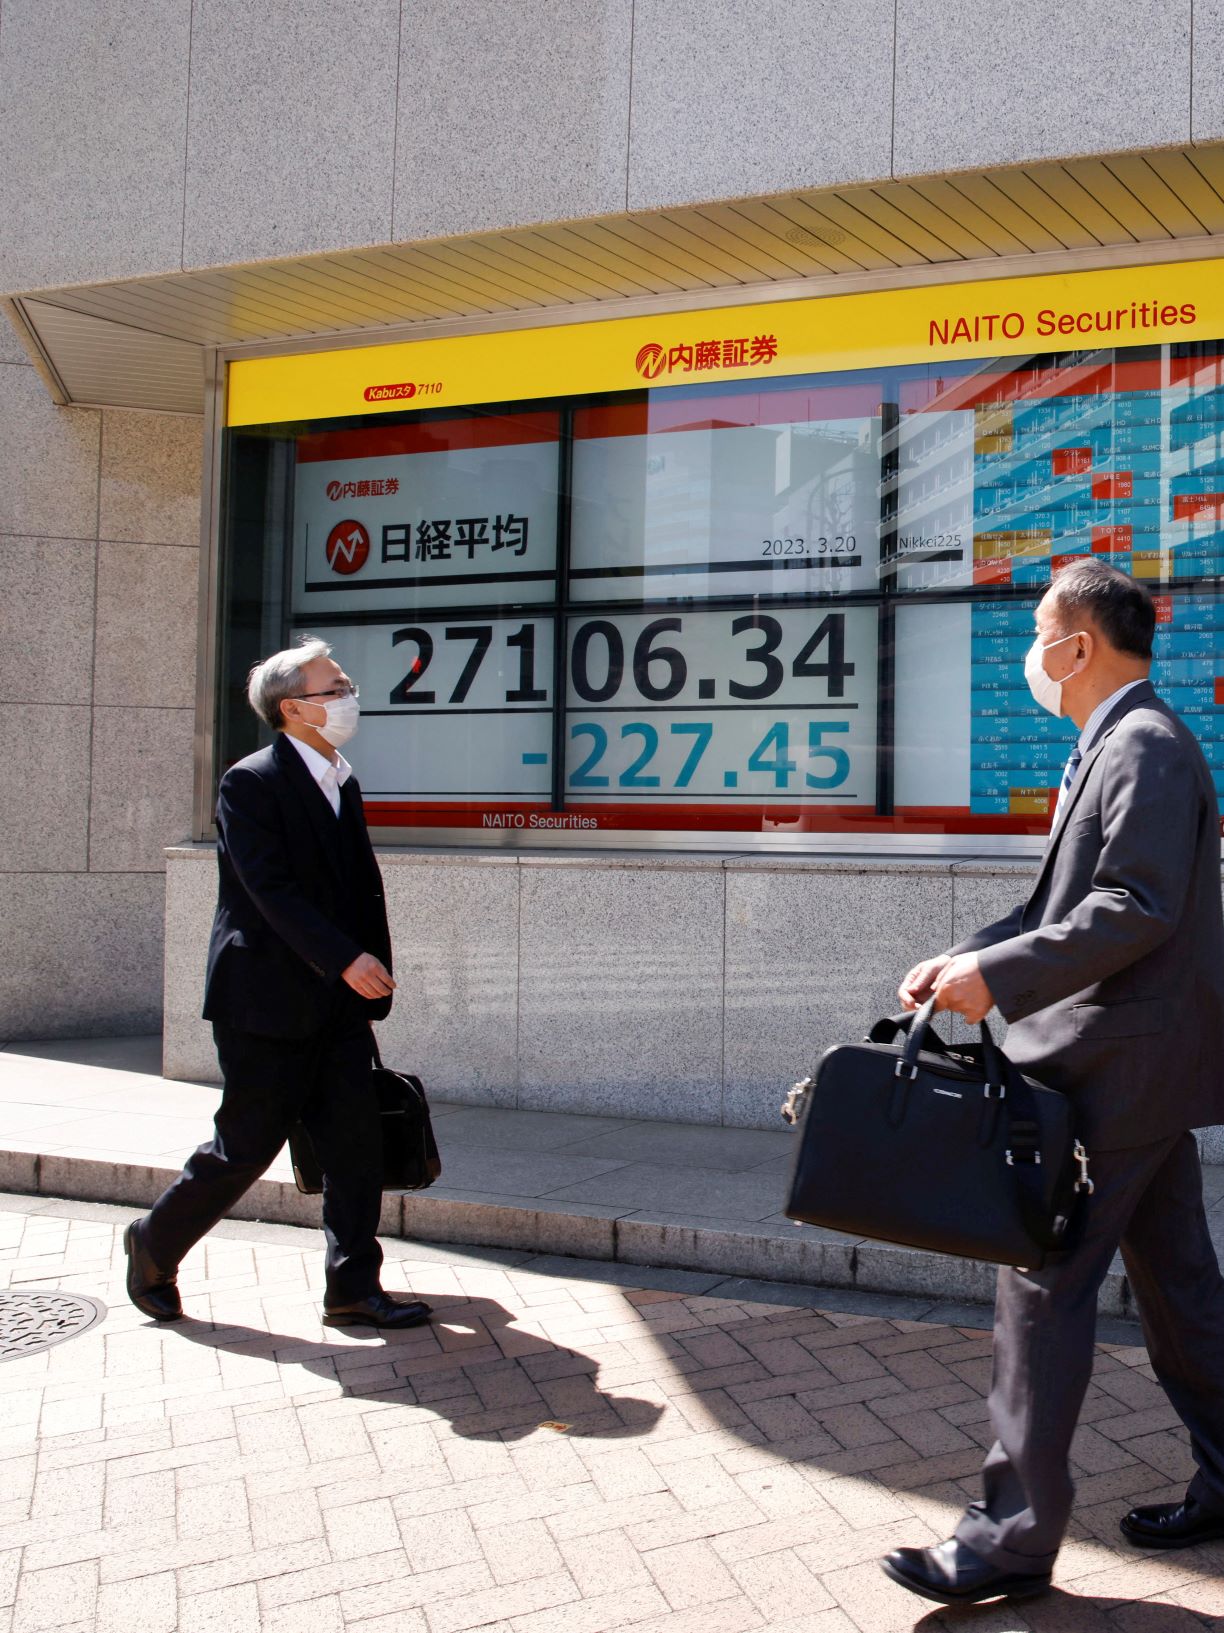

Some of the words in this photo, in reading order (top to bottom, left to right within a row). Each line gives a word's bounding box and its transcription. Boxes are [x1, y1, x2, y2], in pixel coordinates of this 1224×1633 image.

[929, 313, 1024, 346] NAITO
[1037, 300, 1196, 336] Securities
[668, 335, 777, 373] 内藤証券
[418, 383, 442, 395] 7110
[343, 478, 399, 498] 内藤証券
[381, 514, 528, 563] 日経平均
[389, 614, 855, 705] 27106.34
[522, 721, 850, 789] -227.45
[483, 814, 525, 828] NAITO
[529, 814, 598, 828] Securities
